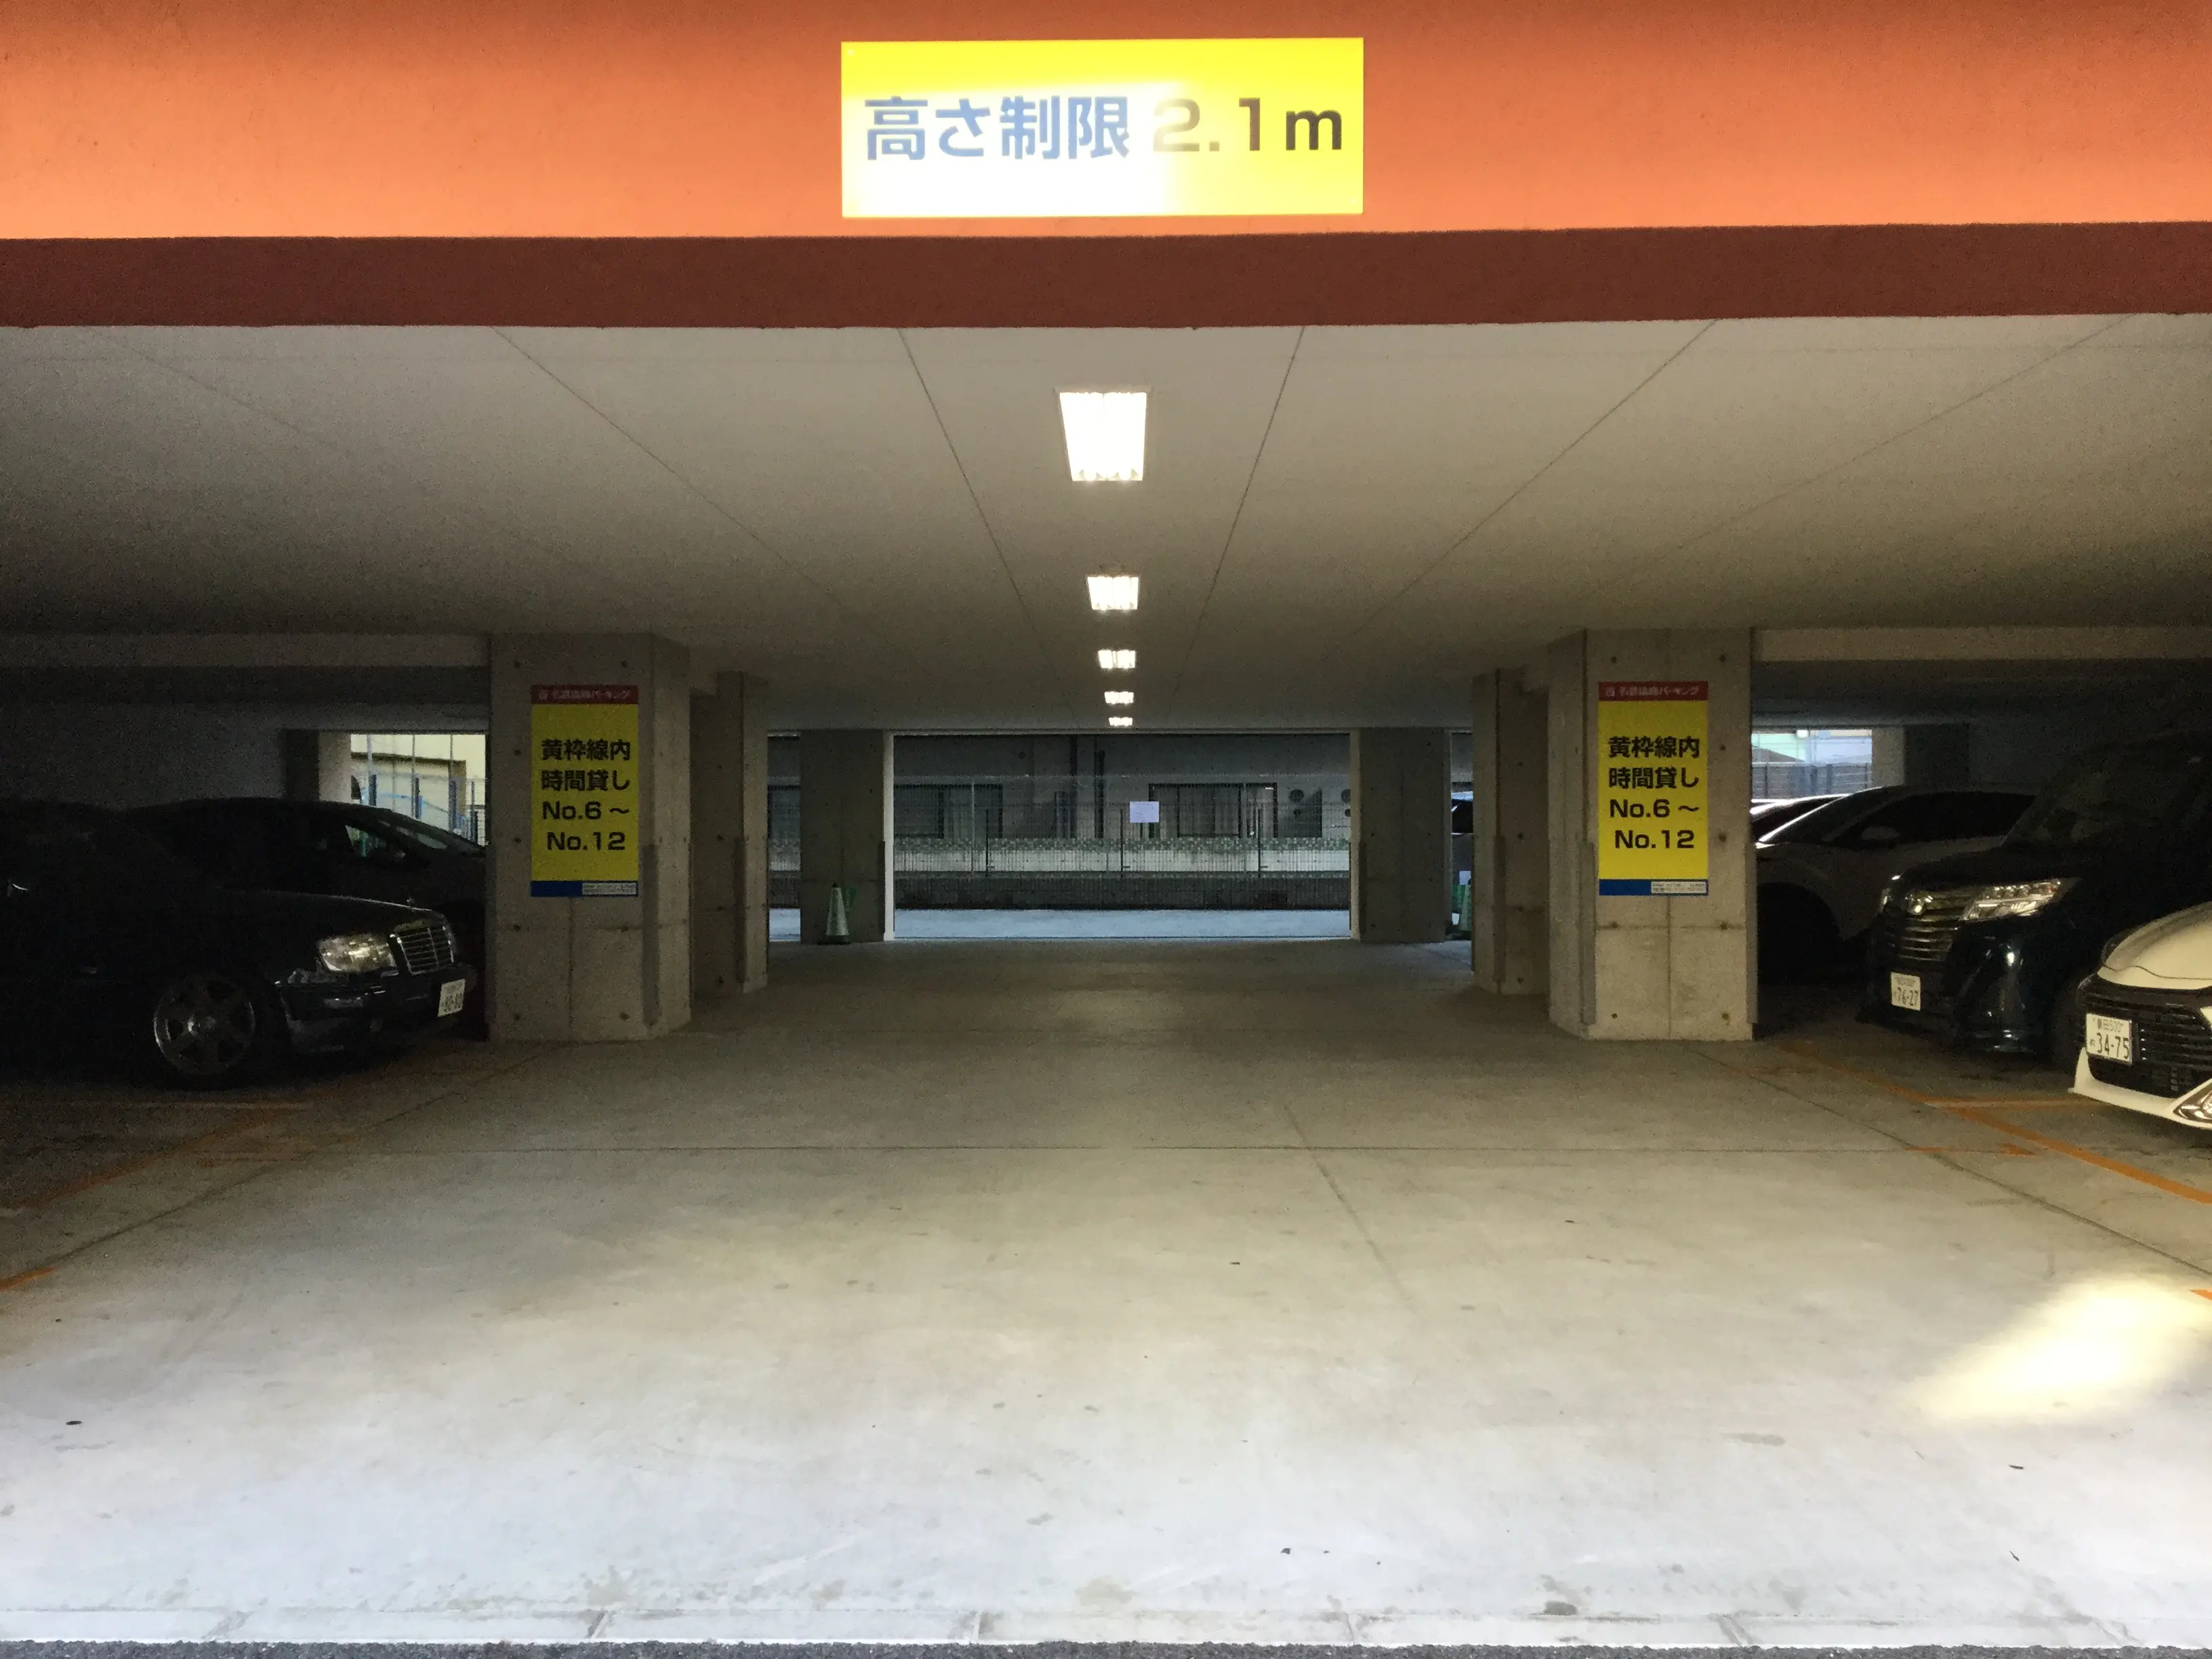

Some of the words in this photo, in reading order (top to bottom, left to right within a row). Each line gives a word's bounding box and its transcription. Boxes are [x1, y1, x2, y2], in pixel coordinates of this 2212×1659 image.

[863, 94, 1130, 161] 高さ制限
[1152, 96, 1343, 152] 2.1m
[541, 738, 631, 761] 黄枠線内
[1608, 735, 1700, 758] 黄枠線内
[541, 770, 630, 792] 時間貸し
[1608, 766, 1700, 789] 時間貸し
[546, 832, 626, 851] No.12
[1614, 830, 1695, 848] No.12
[2097, 1018, 2121, 1033] 田500
[2097, 1032, 2129, 1059] 34-75
